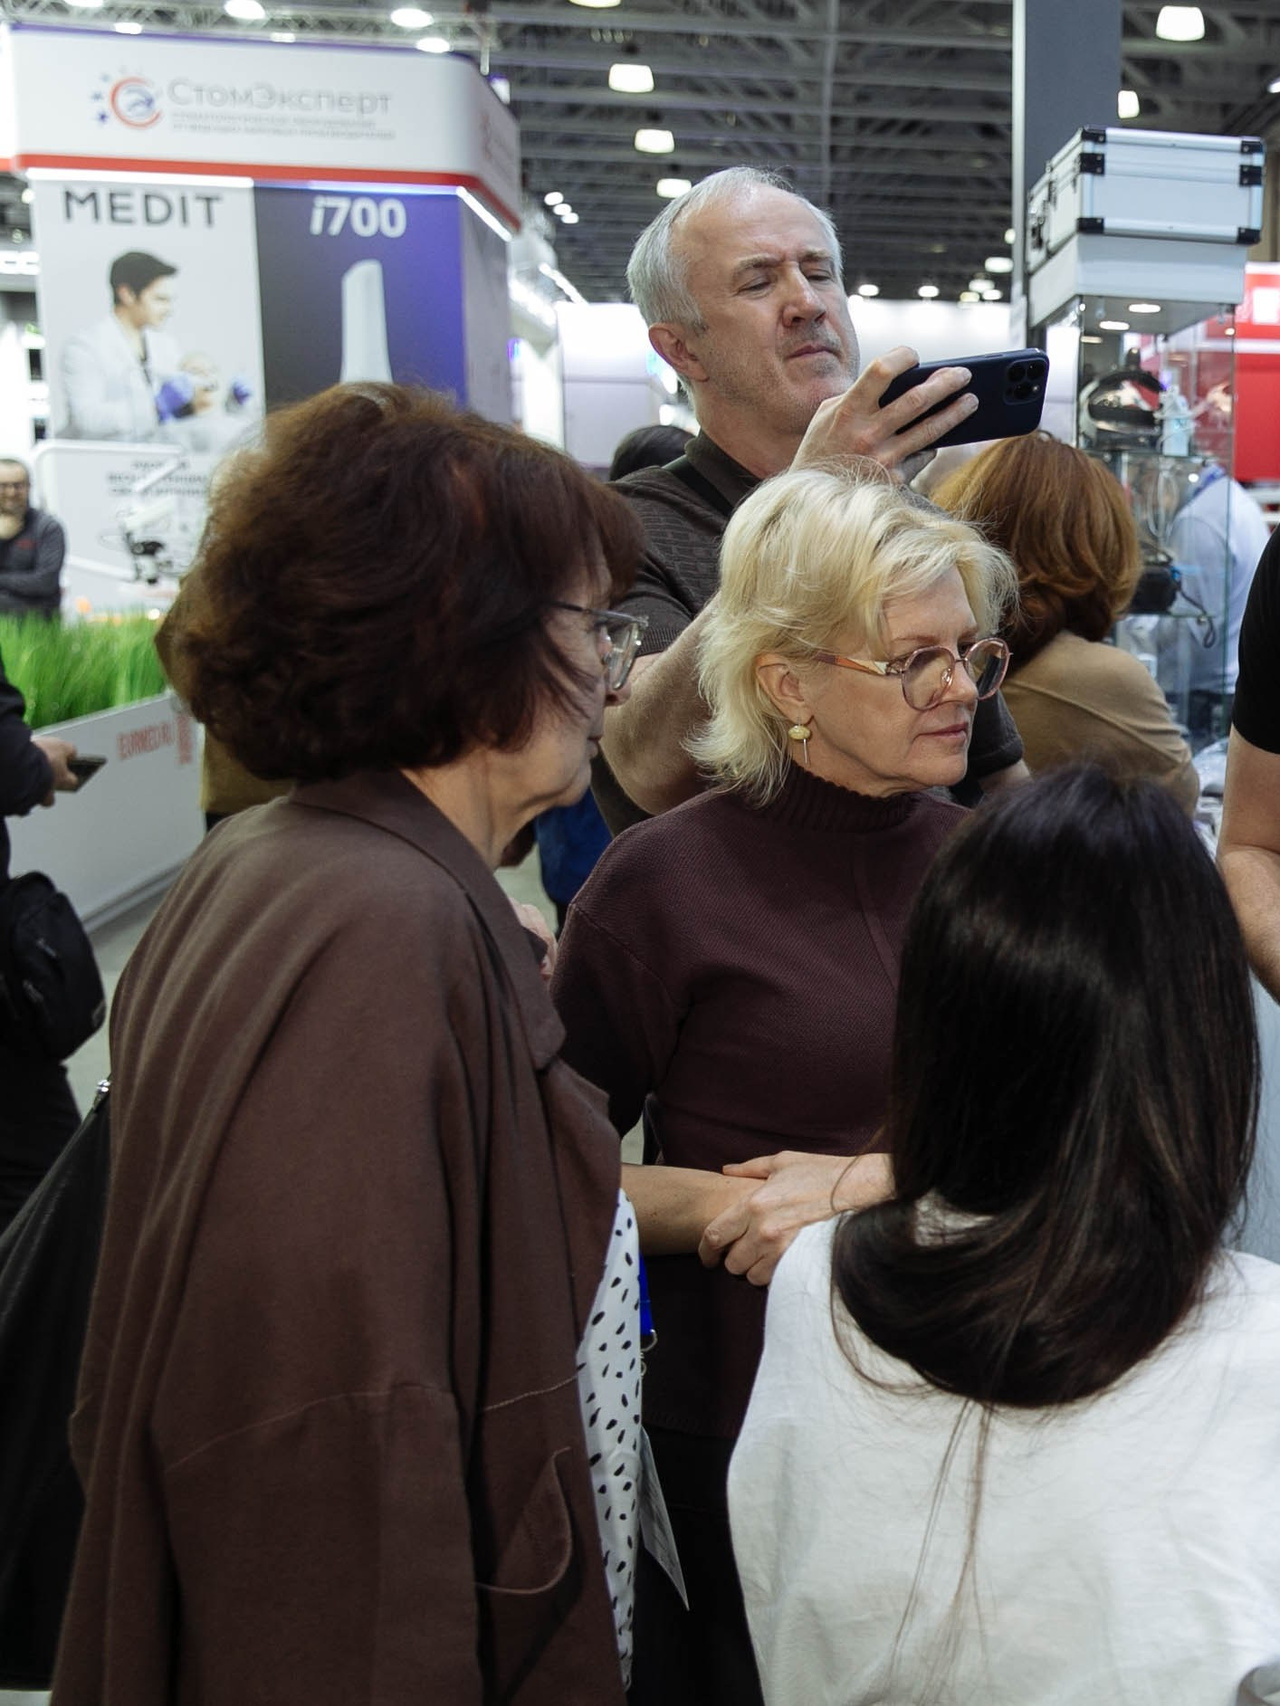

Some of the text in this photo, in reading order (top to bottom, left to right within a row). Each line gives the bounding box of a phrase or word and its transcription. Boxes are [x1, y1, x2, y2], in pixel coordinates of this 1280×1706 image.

[167, 77, 391, 116] СтомЭксперт
[64, 188, 222, 228] MEDIT
[309, 194, 407, 238] i700
